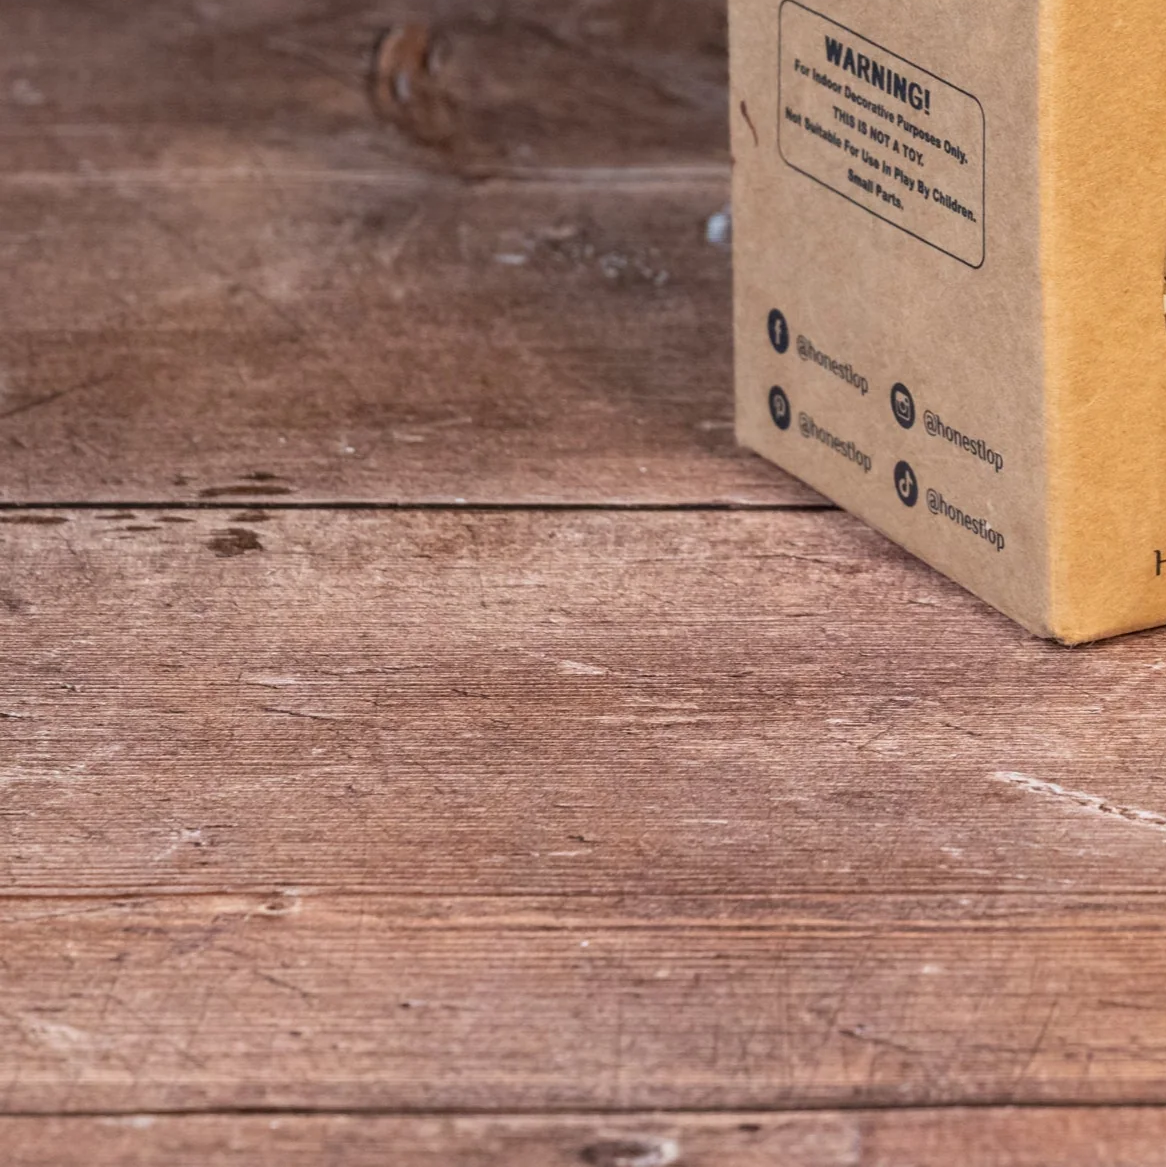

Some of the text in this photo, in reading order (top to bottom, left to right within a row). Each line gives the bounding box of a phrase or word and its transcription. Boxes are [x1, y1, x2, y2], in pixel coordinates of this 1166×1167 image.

[825, 34, 931, 115] WARNING!
[794, 58, 968, 165] For Indoor Decorative Purposes Only.
[832, 105, 924, 168] THIS IS NOT A TOY.
[785, 106, 802, 127] Not
[804, 116, 842, 149] Suitable
[844, 138, 860, 158] For
[861, 148, 880, 170] Use
[894, 166, 915, 192] Play
[917, 180, 930, 200] By
[932, 188, 977, 223] Children.
[848, 167, 904, 211] Small Parts.
[796, 334, 869, 396] @honestlop
[798, 411, 871, 473] @honestlop
[923, 409, 1004, 473] @honestlop
